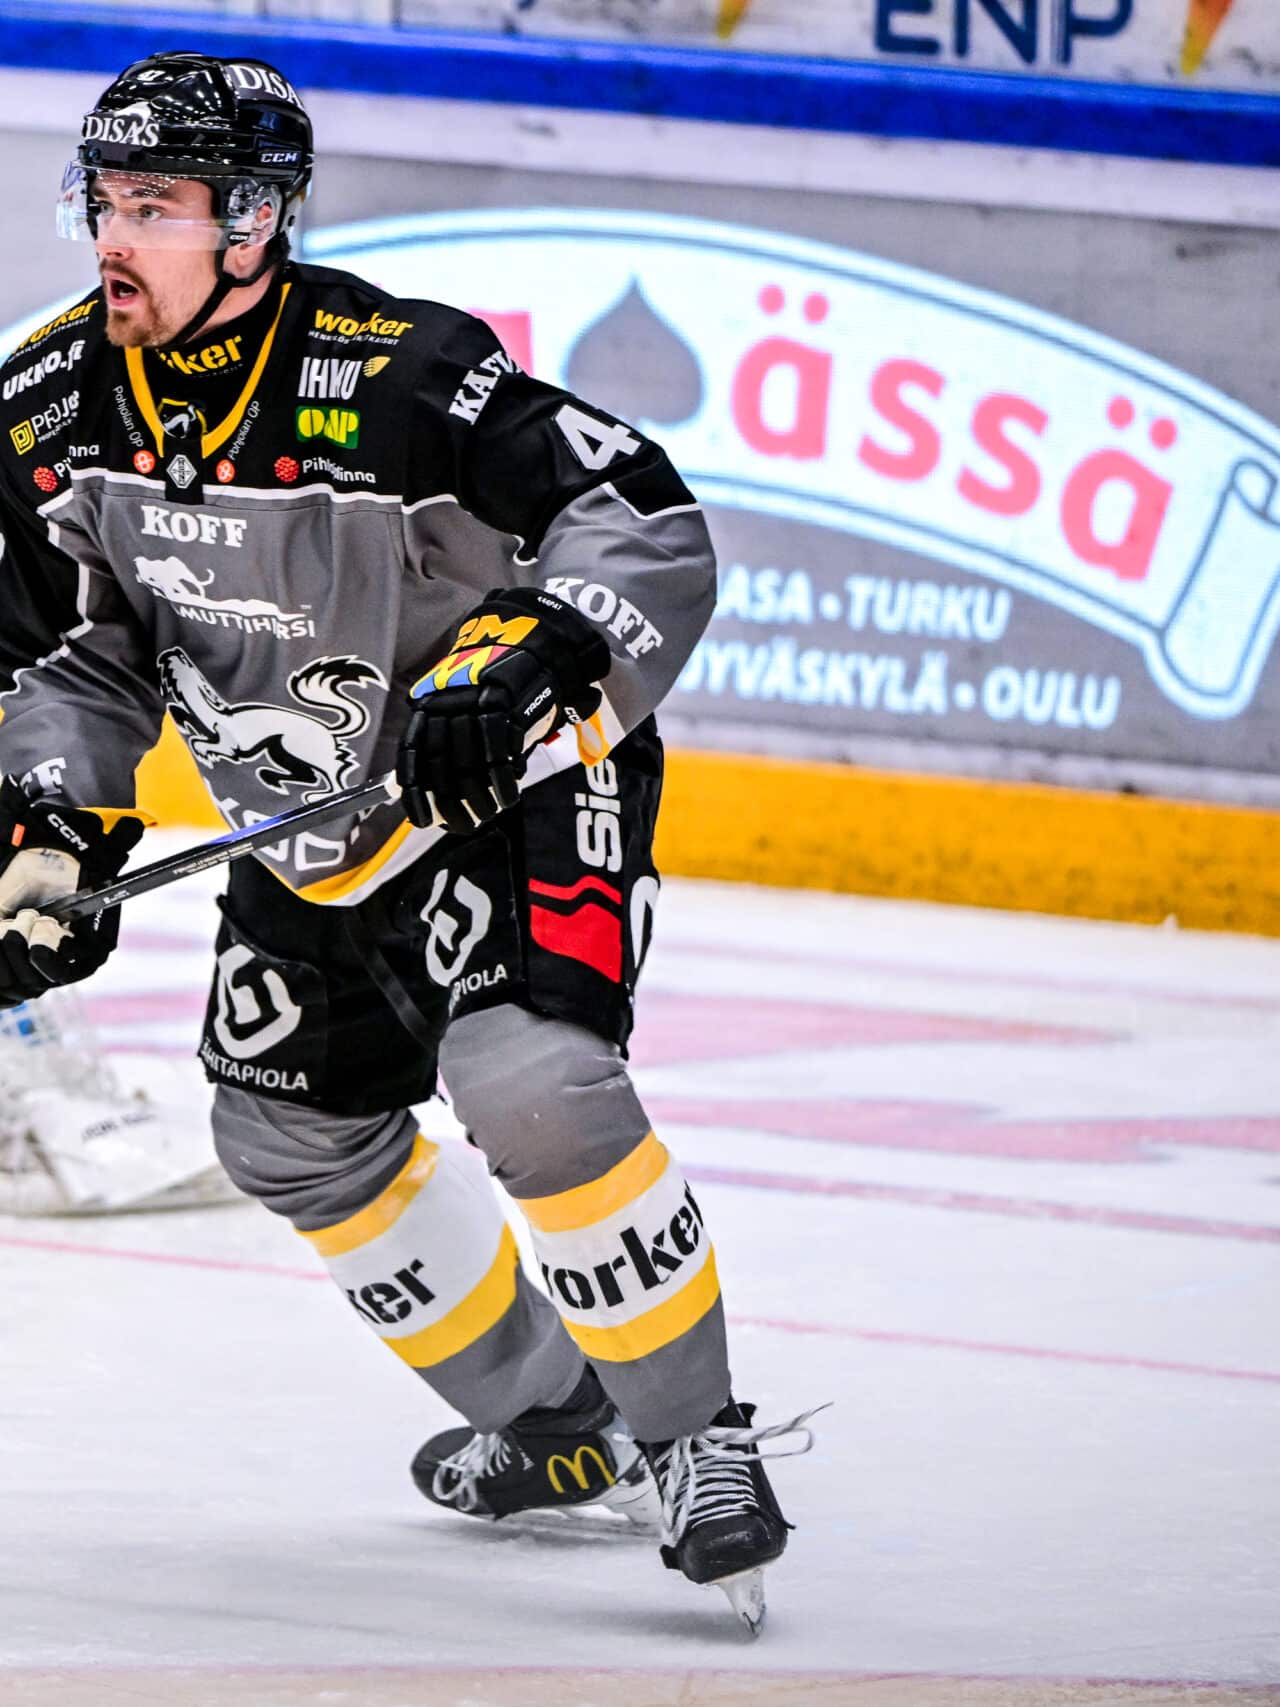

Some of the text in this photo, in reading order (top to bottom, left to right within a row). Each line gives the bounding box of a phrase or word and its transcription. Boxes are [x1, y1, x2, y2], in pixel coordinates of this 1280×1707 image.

[85, 115, 161, 147] DISAS
[261, 152, 298, 163] CCM
[112, 385, 144, 448] Pohjolan OP
[247, 400, 261, 419] OP
[729, 284, 1174, 582] ässä
[141, 505, 247, 547] KOFF
[543, 577, 664, 660] KOFF
[845, 575, 1012, 642] TURKU
[524, 687, 552, 717] TACKS
[564, 706, 584, 724] CC
[982, 665, 1122, 731] OULU
[47, 813, 90, 852] CCM
